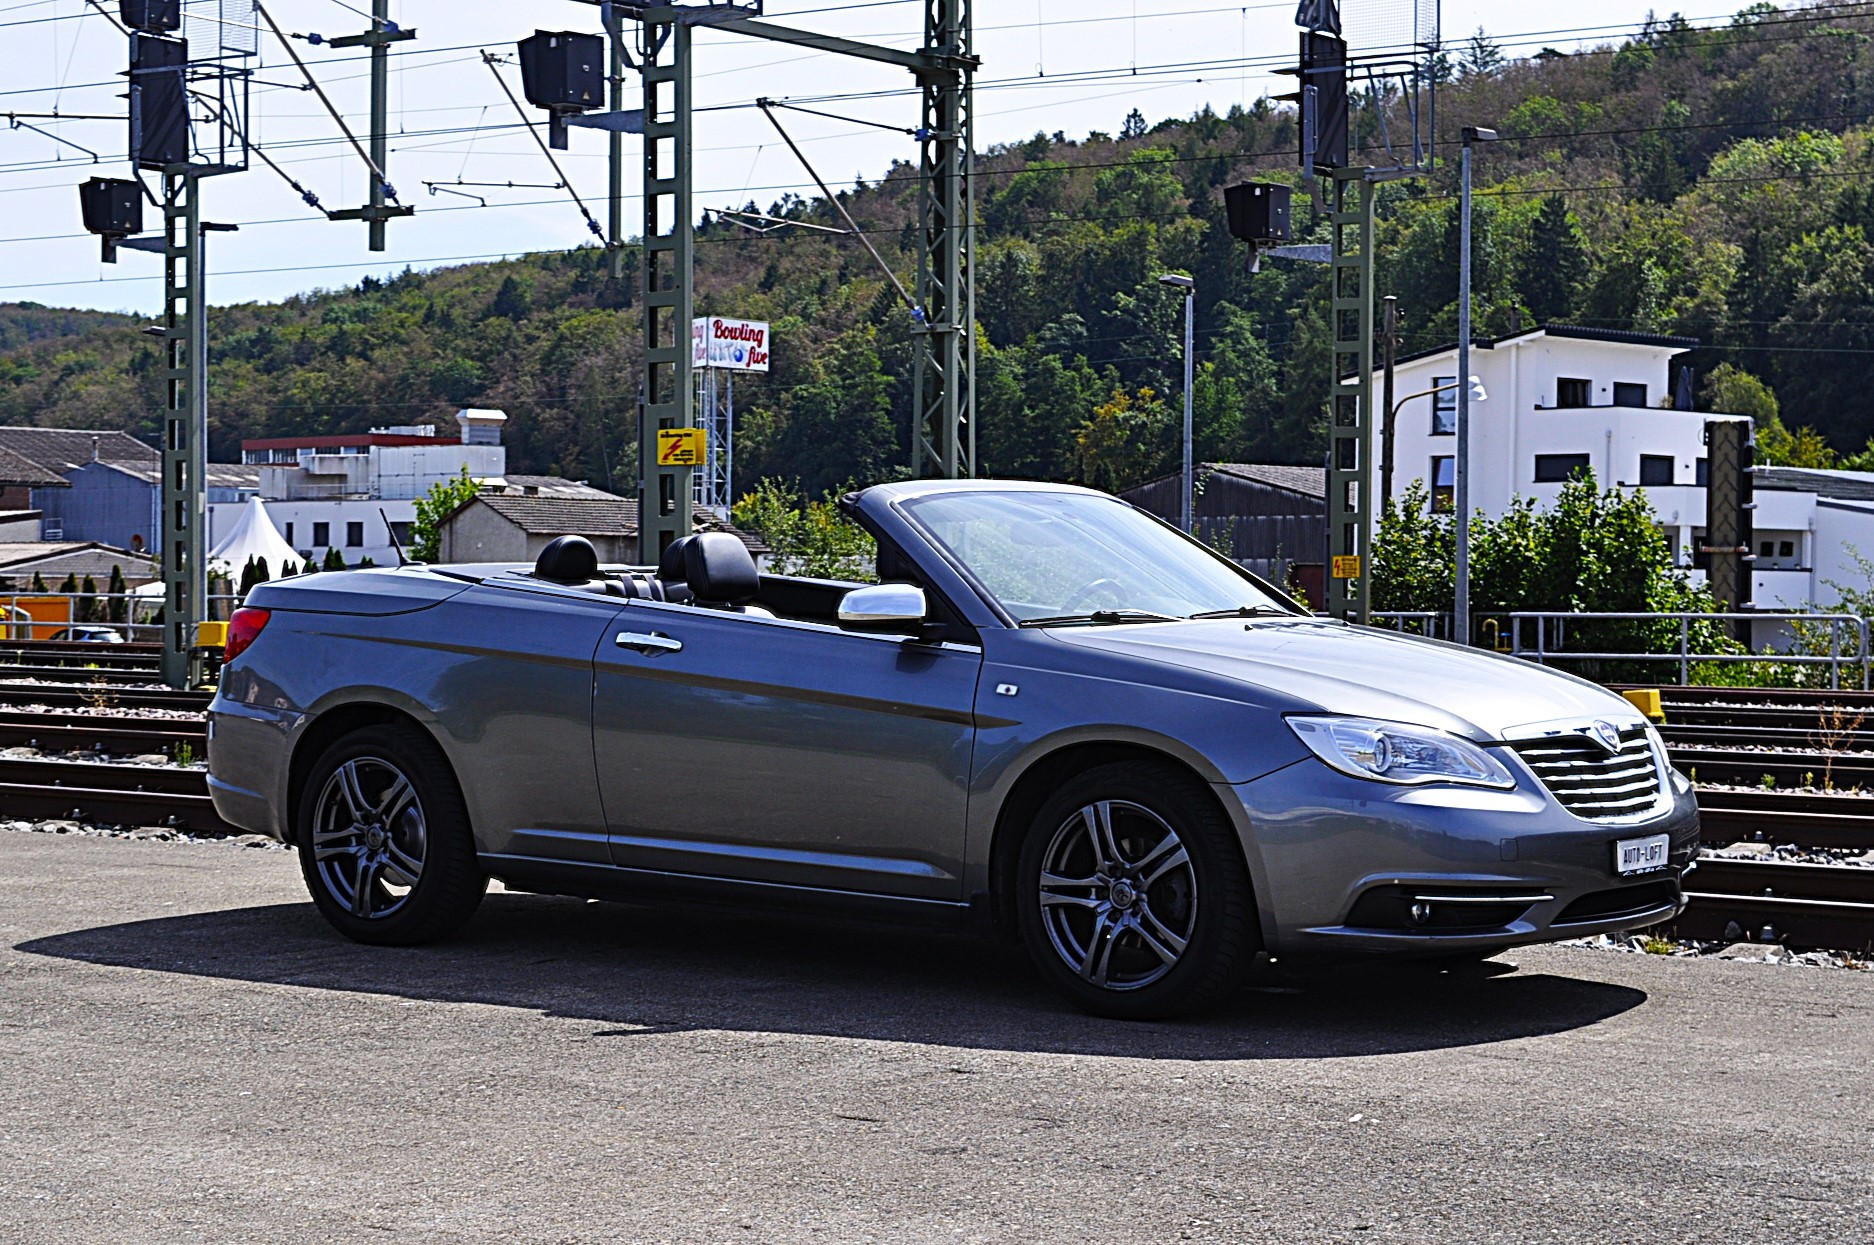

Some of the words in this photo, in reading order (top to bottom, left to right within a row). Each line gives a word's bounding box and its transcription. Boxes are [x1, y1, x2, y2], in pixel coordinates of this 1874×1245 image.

[713, 319, 764, 348] Bowling
[746, 346, 768, 367] five
[1624, 844, 1662, 863] AUTO-LOFT
